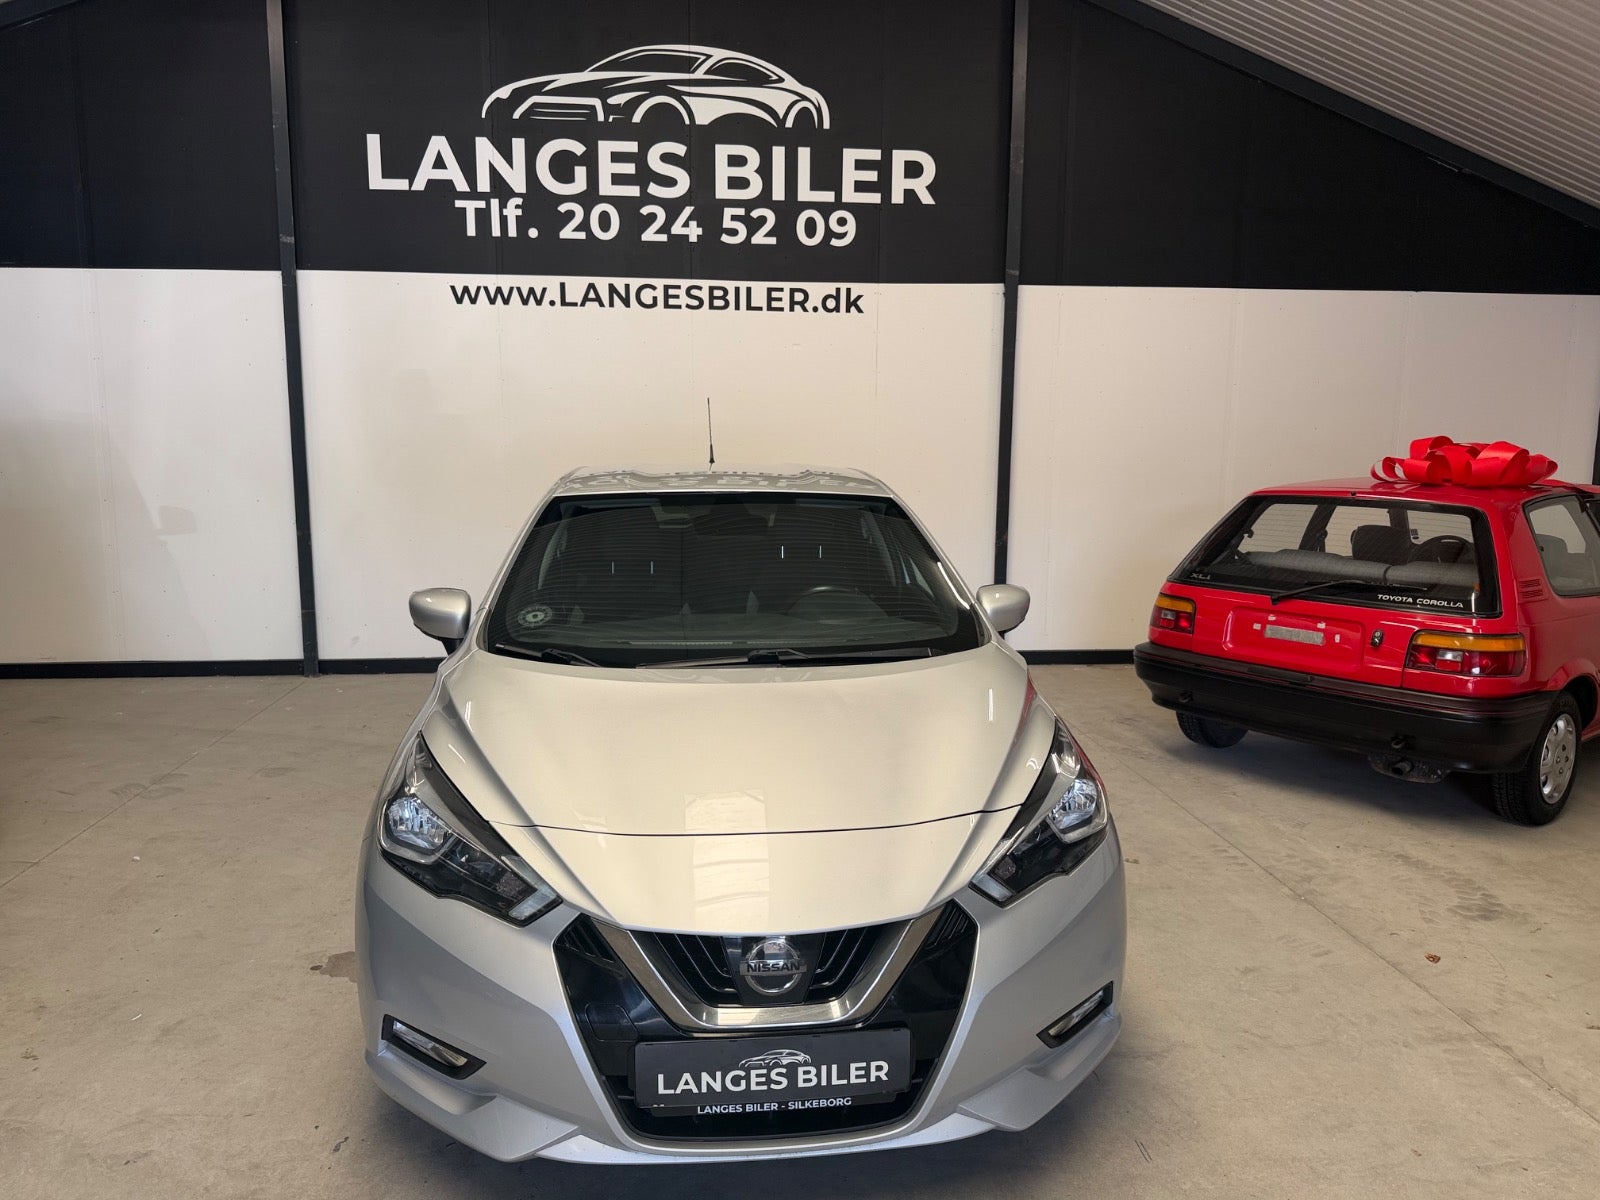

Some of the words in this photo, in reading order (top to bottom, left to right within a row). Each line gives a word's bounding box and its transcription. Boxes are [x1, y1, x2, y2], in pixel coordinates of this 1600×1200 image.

[366, 133, 691, 199] LANGES
[714, 143, 936, 205] BILER
[454, 197, 539, 239] Tlf.
[557, 201, 620, 241] 20
[639, 204, 703, 243] 24
[720, 207, 777, 245] 52
[795, 209, 857, 247] 09
[450, 281, 864, 314] www.LANGESBILER.dk
[1377, 594, 1413, 603] TOYOTA
[1416, 598, 1464, 608] COROLLA
[746, 961, 801, 973] NISSAN
[657, 1068, 788, 1095] LANGES
[796, 1060, 889, 1088] BILER
[697, 1103, 743, 1114] LANGES
[745, 1102, 779, 1112] BILER
[788, 1097, 852, 1110] SILKEBORG
